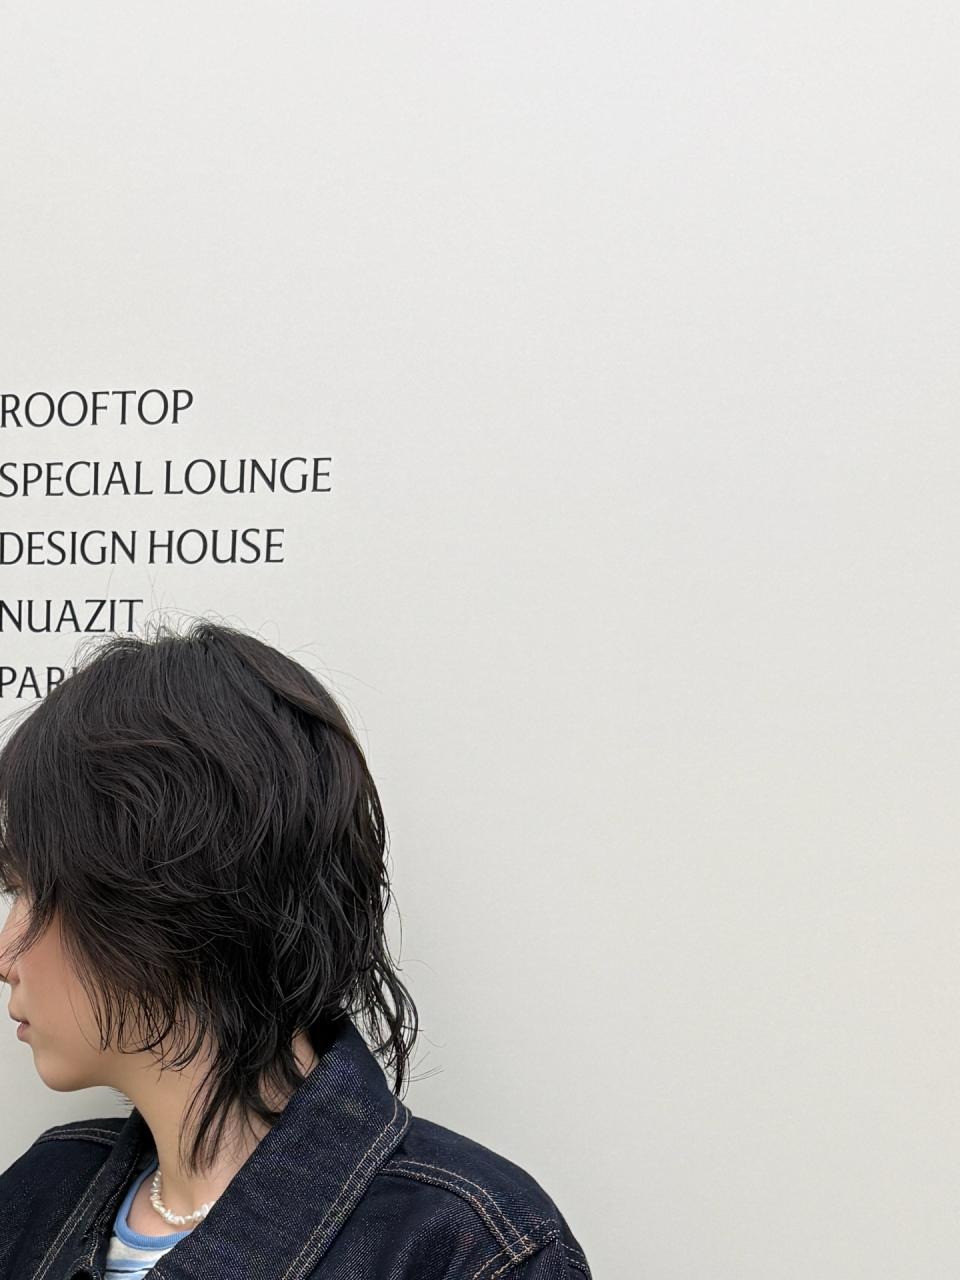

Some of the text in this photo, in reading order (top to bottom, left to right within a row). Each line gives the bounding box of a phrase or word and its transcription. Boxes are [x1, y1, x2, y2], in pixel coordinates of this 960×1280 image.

[0, 389, 194, 428] ROOFTOP
[164, 457, 332, 495] LOUNGE
[148, 528, 285, 564] HOUSE
